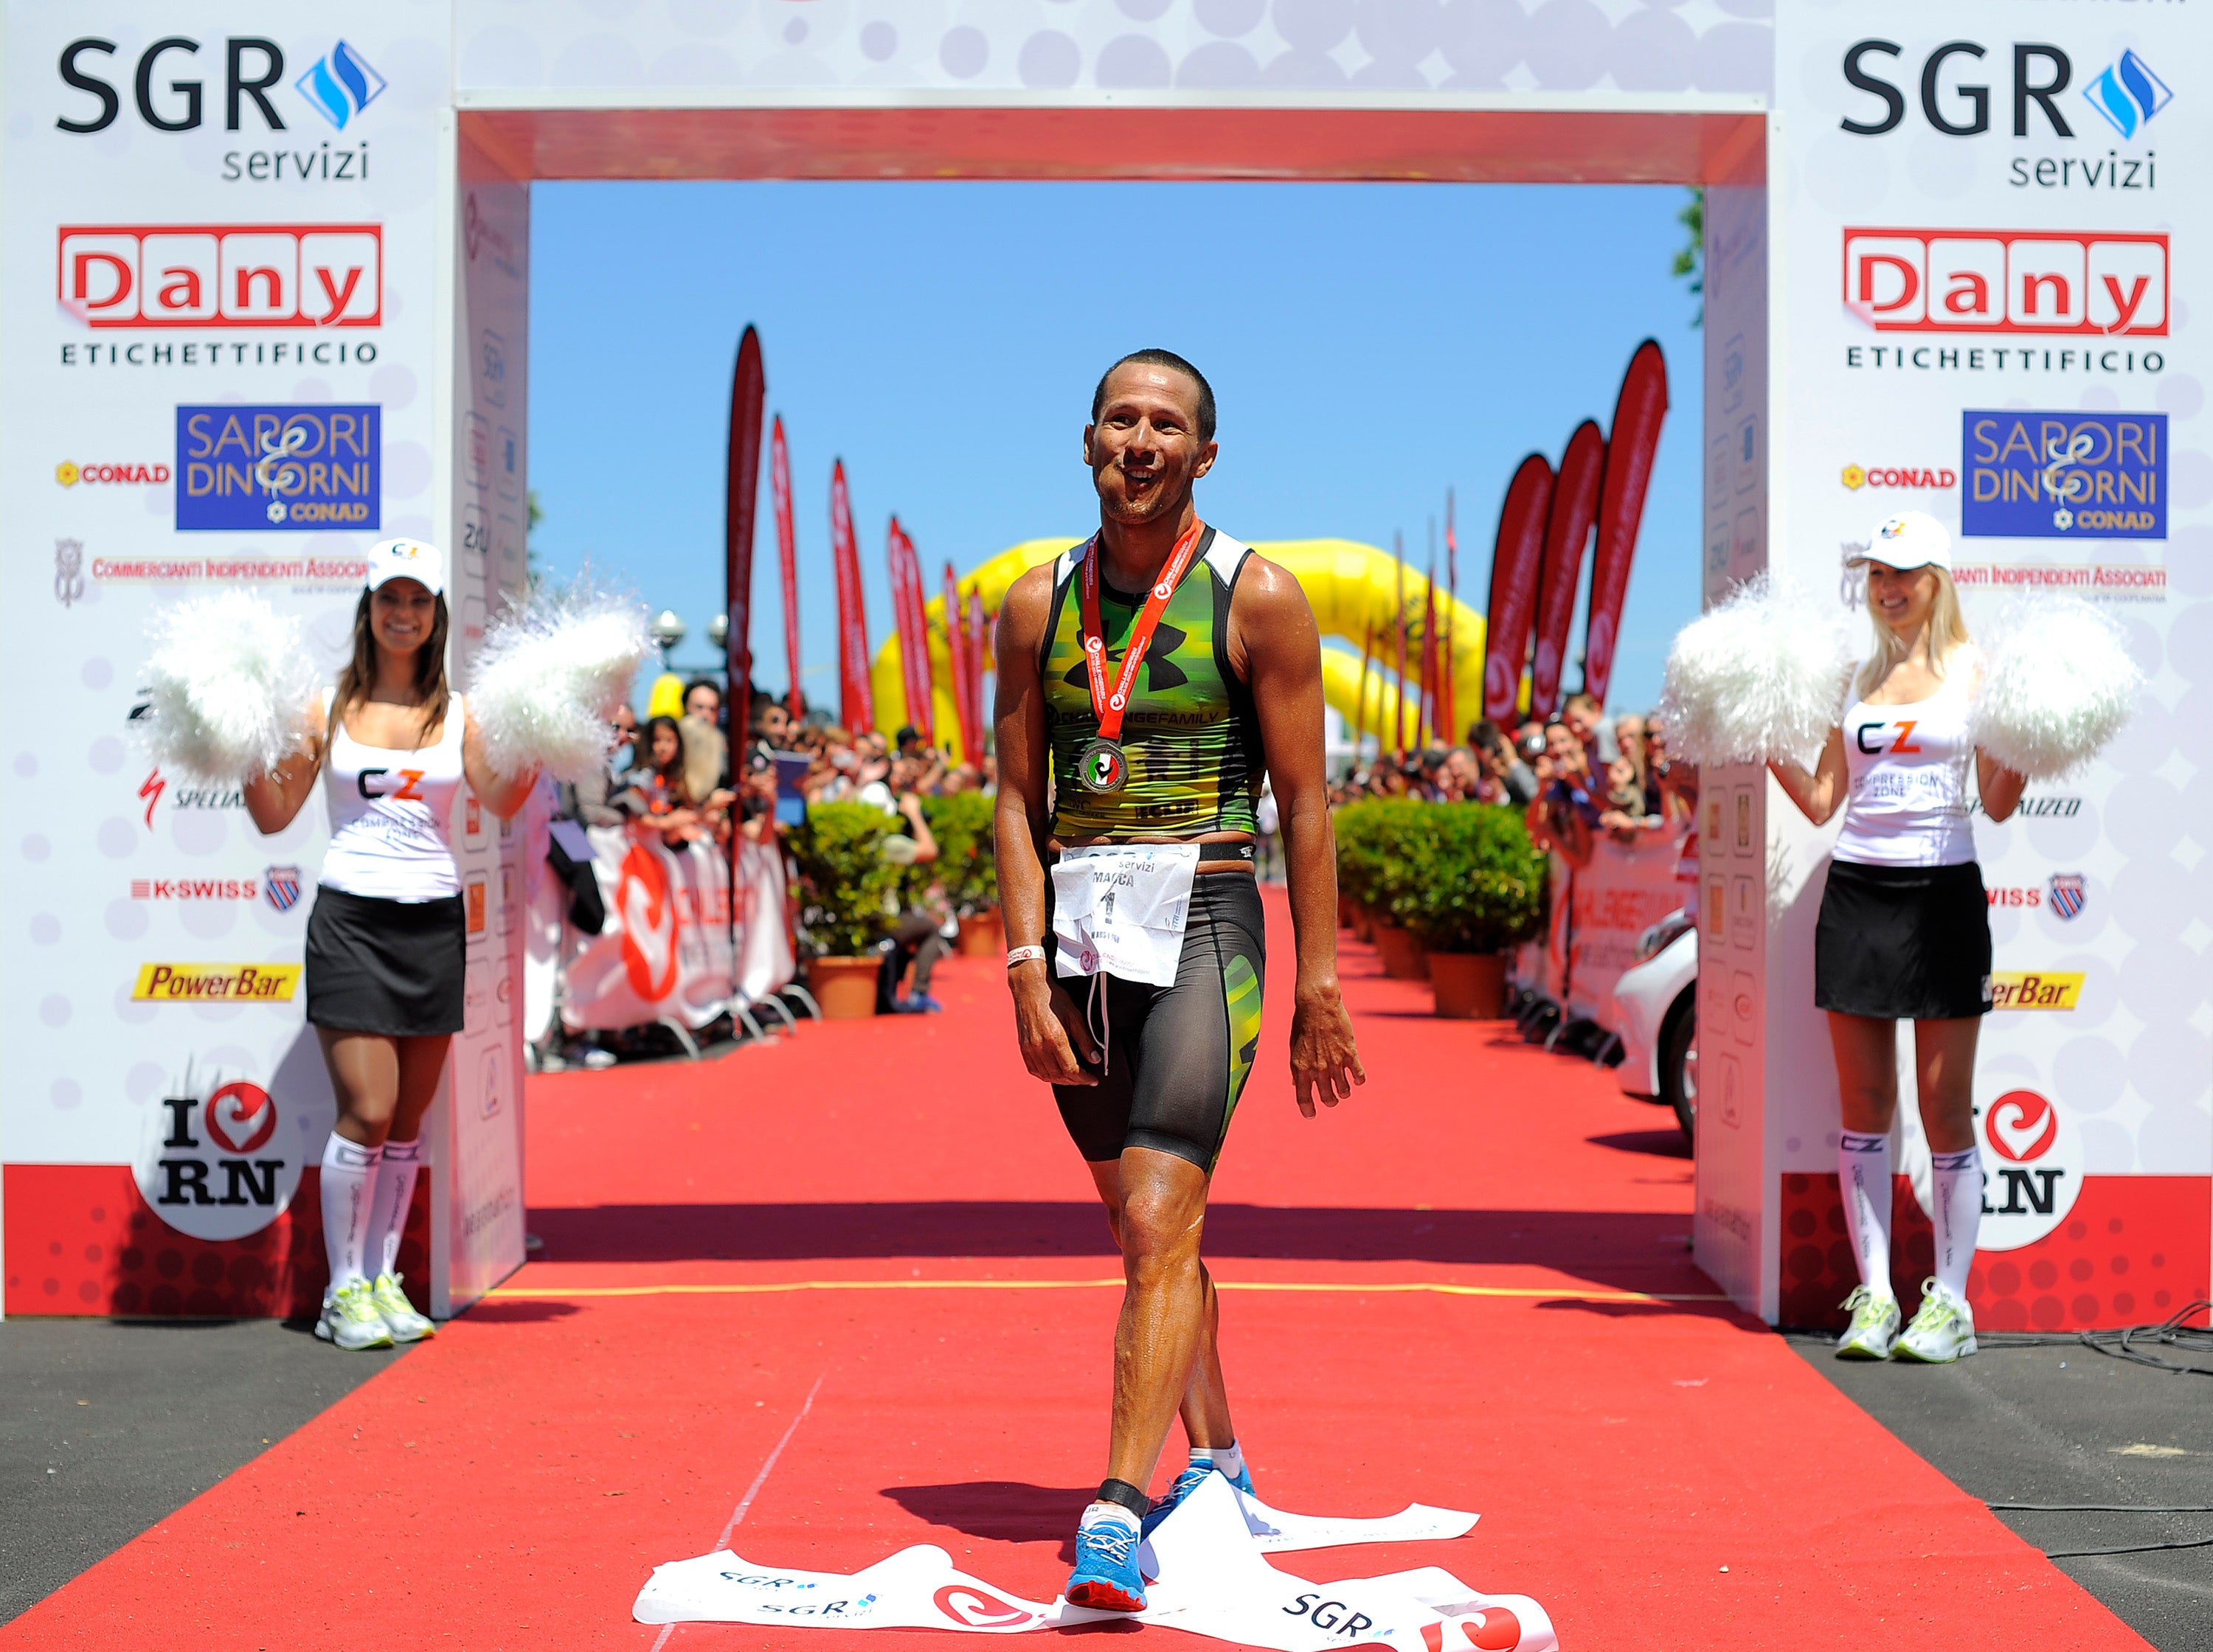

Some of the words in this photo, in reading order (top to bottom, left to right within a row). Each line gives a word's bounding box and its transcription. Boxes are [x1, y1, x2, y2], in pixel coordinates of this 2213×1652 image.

[56, 37, 287, 133] SGR
[1840, 38, 2076, 138] SGR
[221, 142, 369, 181] servizi
[2009, 149, 2156, 189] servizi
[74, 252, 361, 326] Dany
[1859, 254, 2150, 334] Dany
[61, 342, 378, 366] ETICHETTIFICIO
[1846, 346, 2166, 373] ETICHETTIFICIO
[187, 413, 369, 458] SAPORI
[1974, 420, 2157, 466] SAPORI
[82, 465, 170, 483] CONAD
[187, 462, 369, 496] DINTORNI
[1867, 468, 1956, 488] CONAD
[1973, 468, 2157, 504] DINTORNI
[290, 502, 368, 522] CONAD
[2077, 510, 2155, 530] CONAD
[92, 558, 201, 579] COMMERCIANTI
[206, 558, 303, 579] INDIPENDENTI
[306, 558, 368, 579] ASSOCIA
[1992, 564, 2090, 585] INDIPENDENTI
[2093, 565, 2167, 586] ASSOCIATI
[1857, 720, 1922, 754] CZ
[357, 768, 426, 801] CZ
[1092, 872, 1135, 887] MACCA
[1118, 860, 1155, 873] servizi
[1100, 892, 1115, 925] 1
[148, 966, 288, 998] PowerBar
[1991, 977, 2071, 1005] erBar
[163, 1099, 199, 1148] I
[158, 1159, 285, 1205] RN
[720, 1571, 794, 1588] SGR
[757, 1600, 849, 1615] SGR
[1281, 1593, 1373, 1638] SGR
